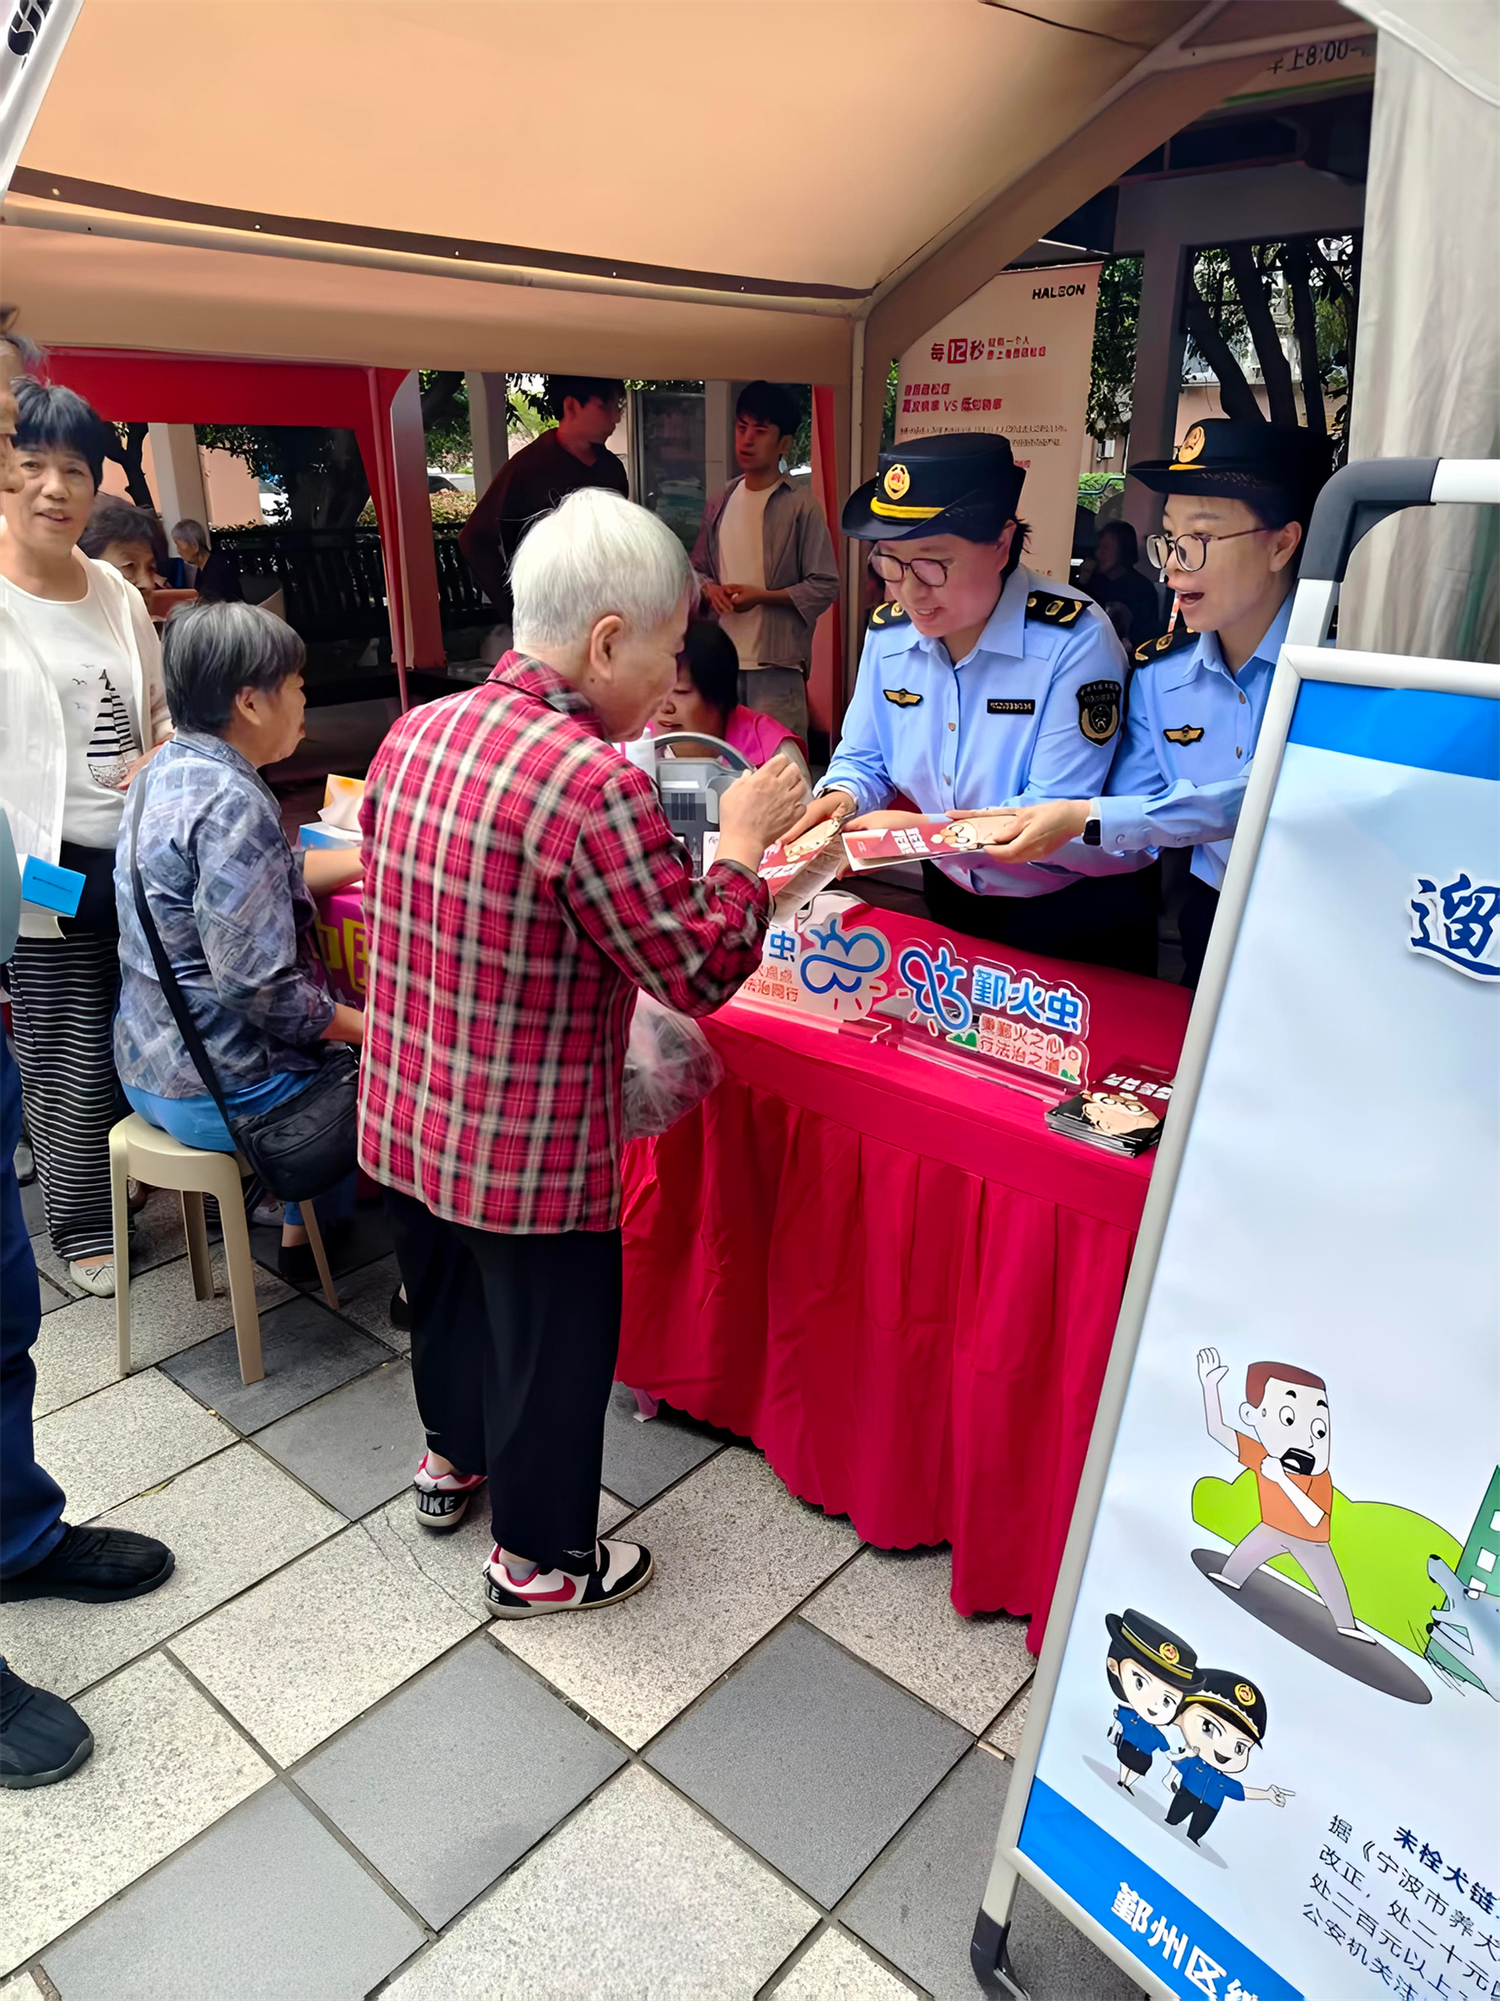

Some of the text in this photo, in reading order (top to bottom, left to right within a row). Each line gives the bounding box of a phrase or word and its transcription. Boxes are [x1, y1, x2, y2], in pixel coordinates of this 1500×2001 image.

[1032, 284, 1086, 300] HALEON
[943, 399, 959, 412] VS
[973, 967, 1080, 1033] 鄞火虫
[1327, 1814, 1500, 1962] 据《宁波市养犬
[1393, 1825, 1500, 1920] 未栓犬链
